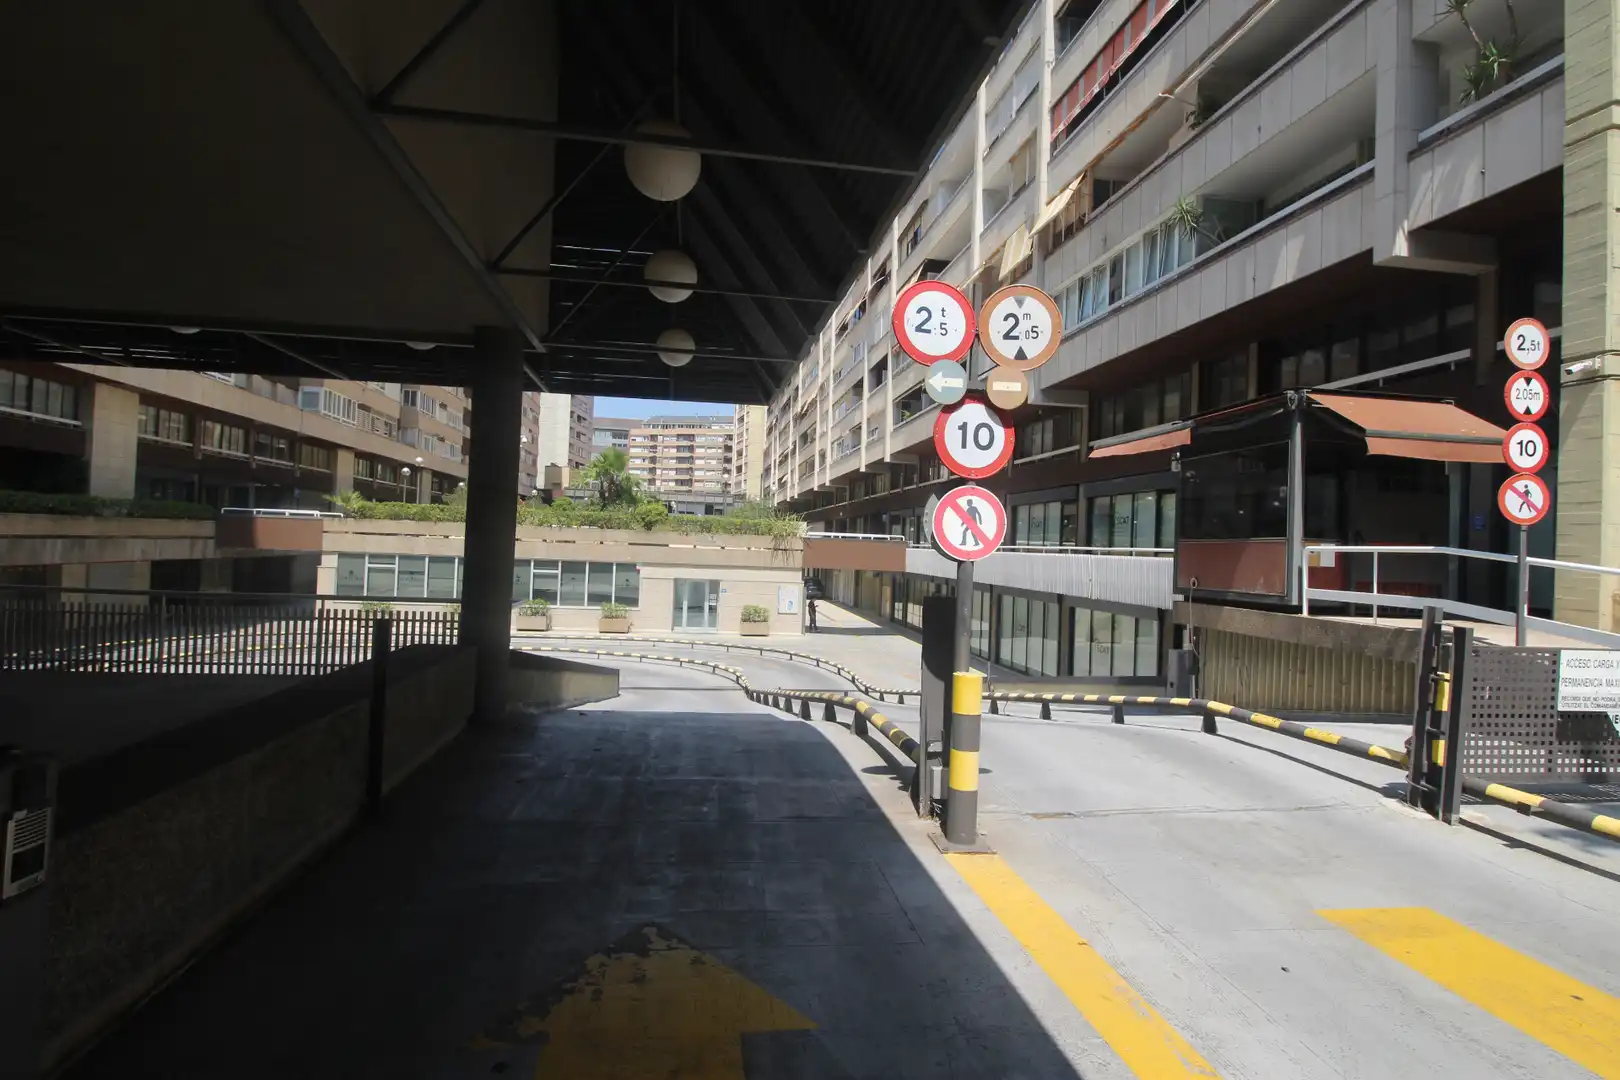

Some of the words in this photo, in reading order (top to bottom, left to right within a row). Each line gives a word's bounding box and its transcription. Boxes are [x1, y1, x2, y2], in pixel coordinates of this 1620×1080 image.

[957, 421, 995, 451] 10
[1516, 440, 1537, 457] 10
[1593, 660, 1614, 669] CARGA
